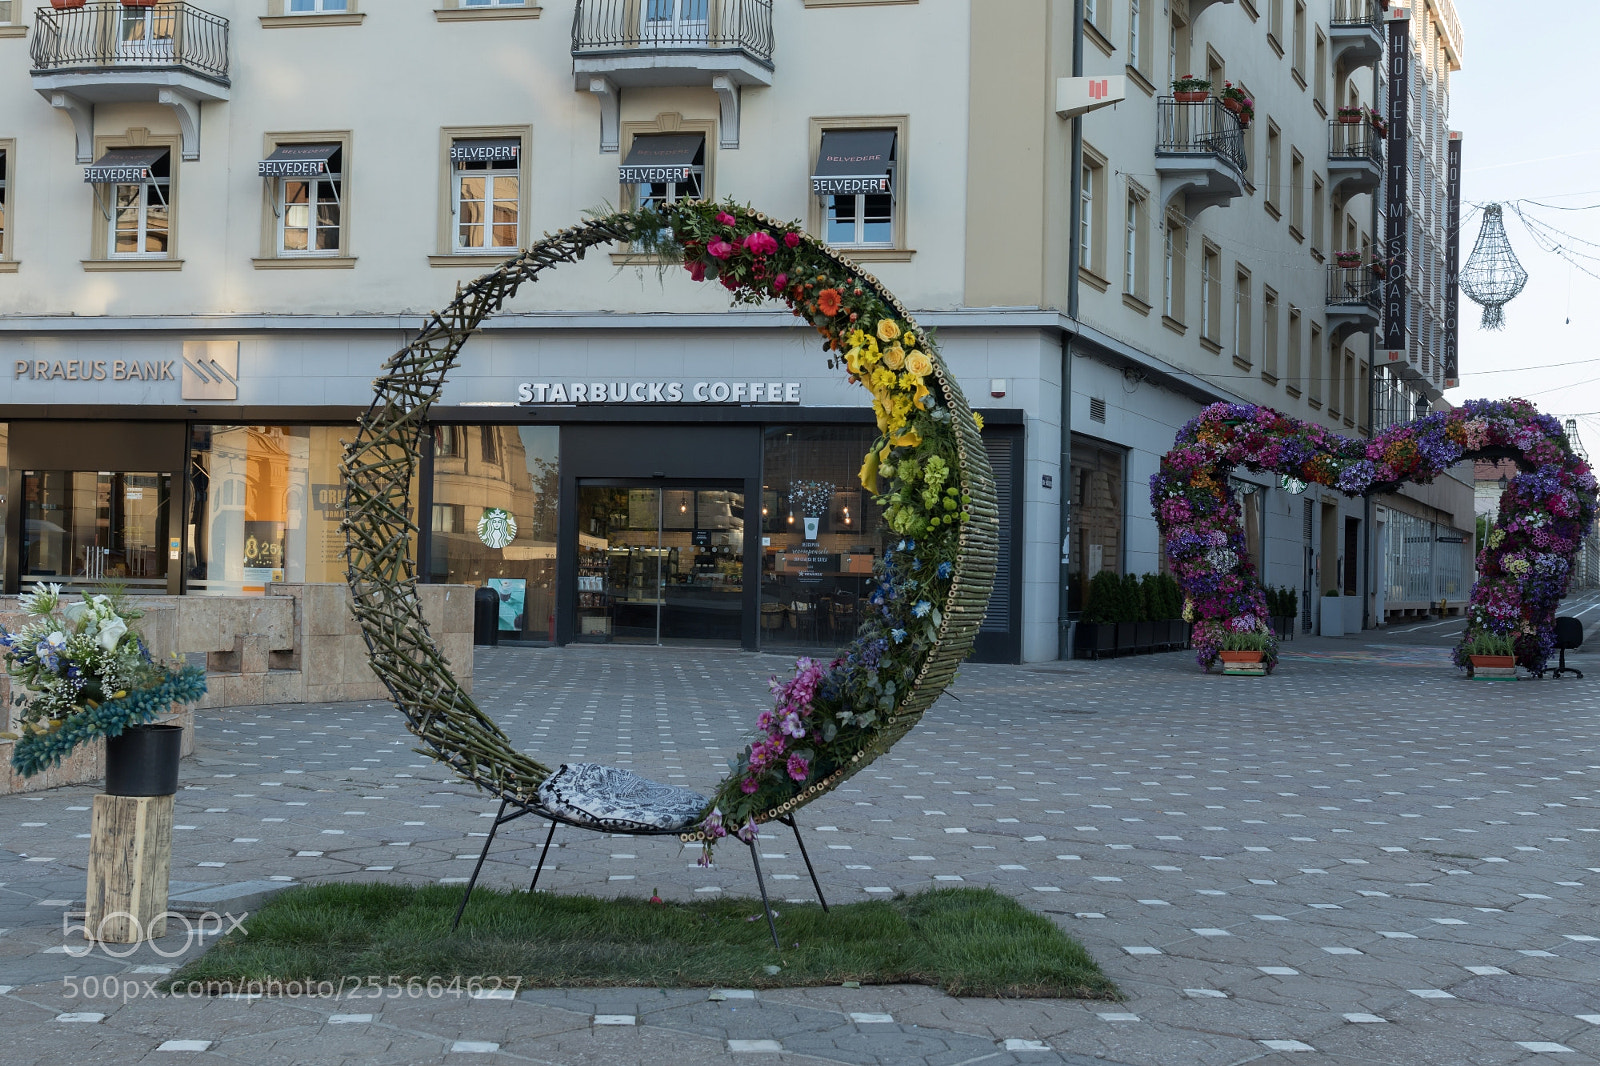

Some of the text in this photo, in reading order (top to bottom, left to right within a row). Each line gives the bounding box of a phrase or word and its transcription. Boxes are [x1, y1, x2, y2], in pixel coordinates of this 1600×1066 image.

[1392, 35, 1404, 140] HOTEL
[451, 146, 517, 158] BELVEDERE
[827, 154, 881, 162] BELVEDERE
[84, 168, 147, 179] BELVEDERE
[258, 162, 324, 173] BELVEDERE
[619, 167, 689, 180] BELVEDERE
[813, 179, 886, 191] BELVEDERE
[1449, 151, 1458, 228] HOTEL
[15, 360, 175, 381] PIRAEUS BANK
[518, 382, 801, 403] STARBUCKS COFFEE
